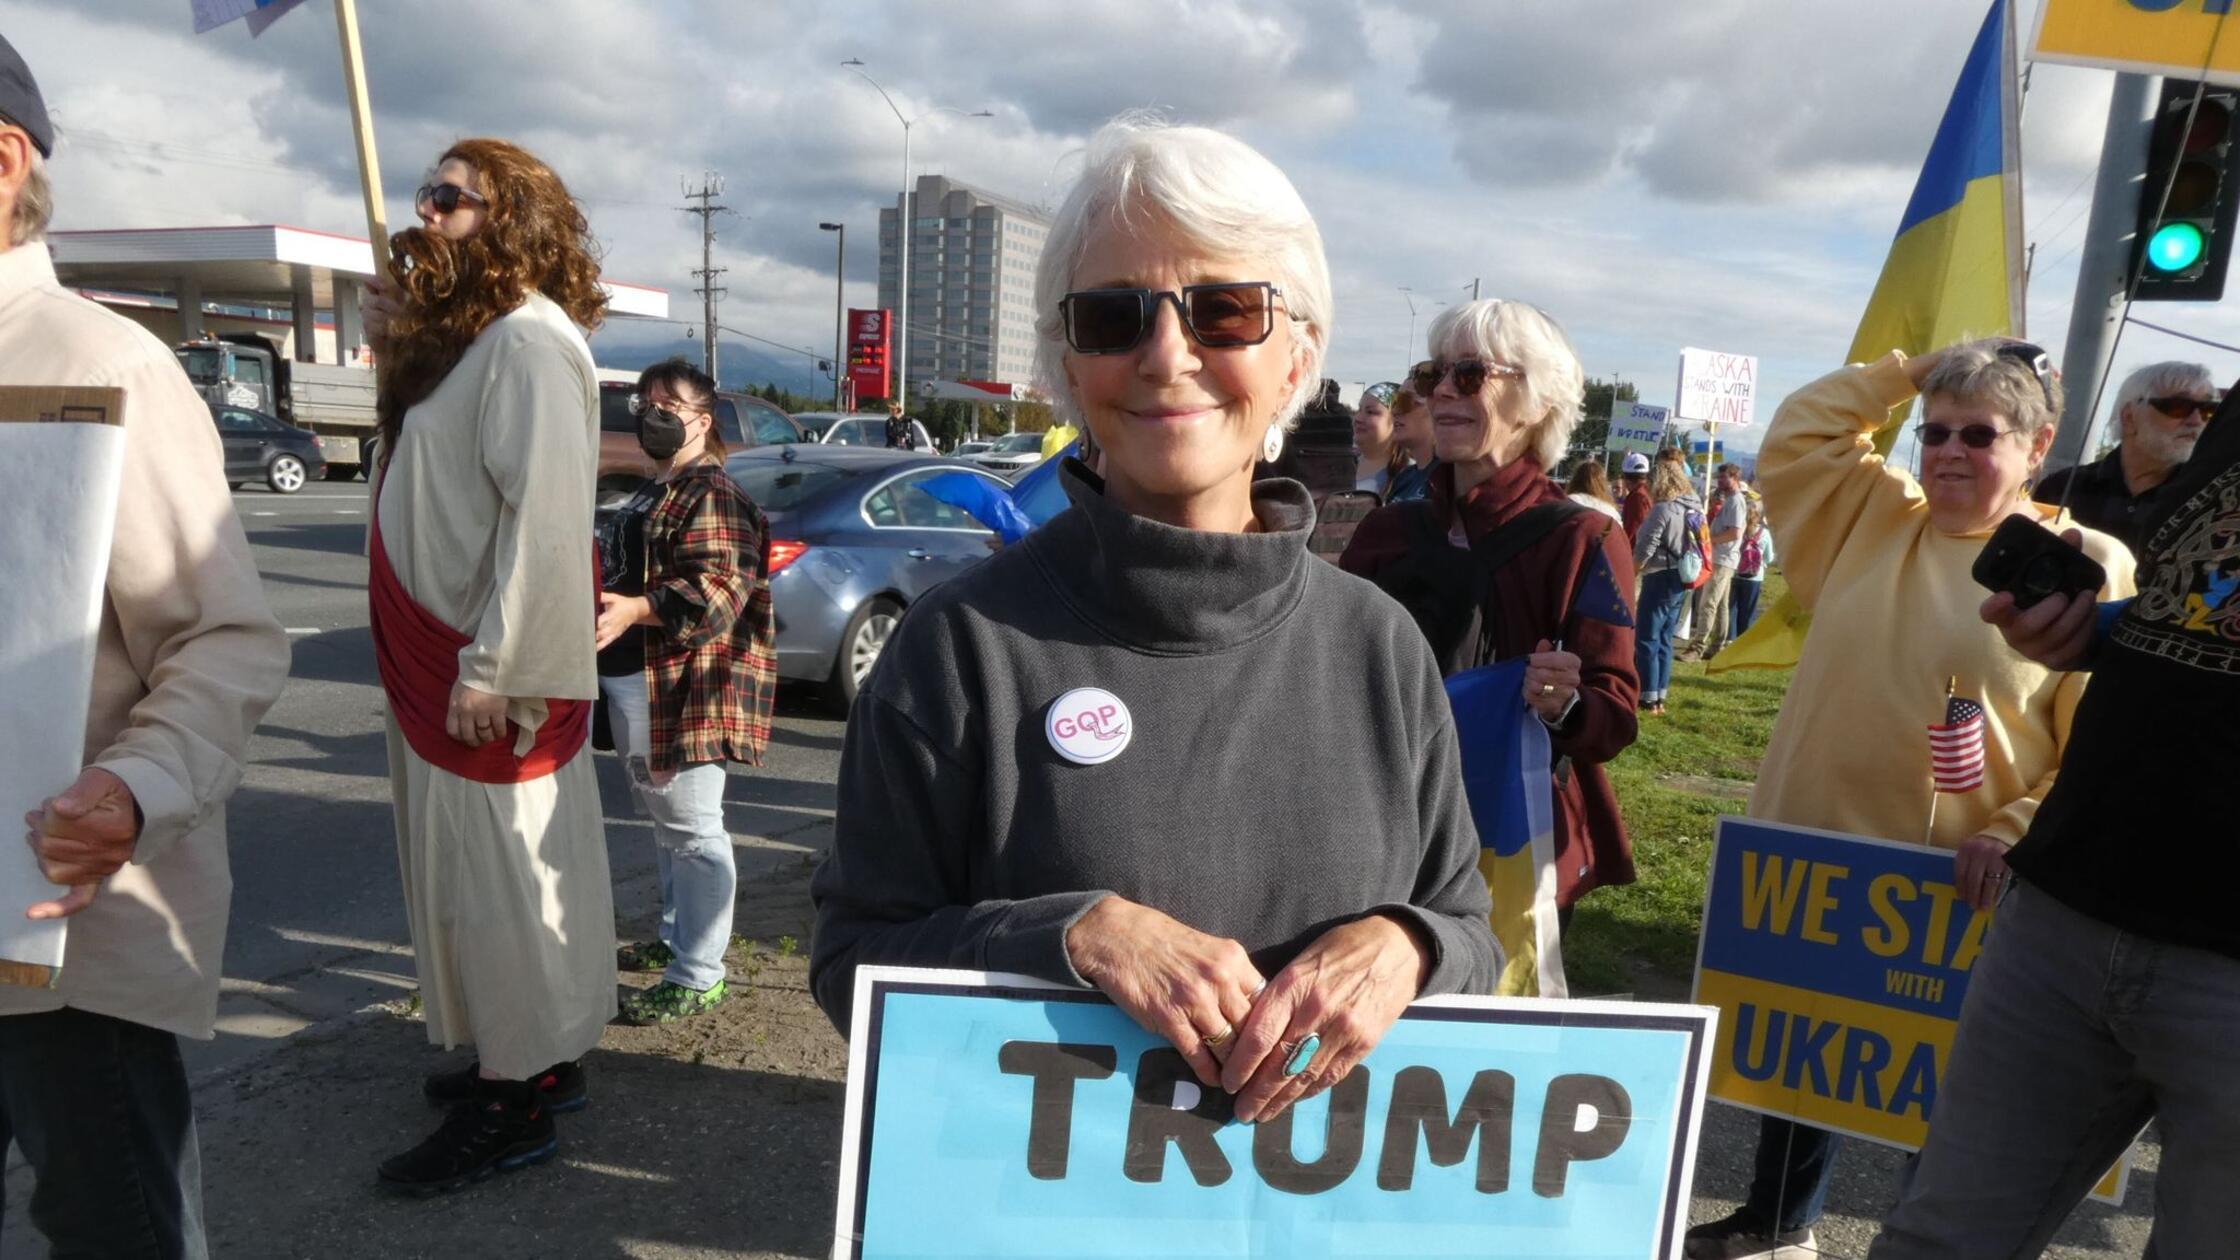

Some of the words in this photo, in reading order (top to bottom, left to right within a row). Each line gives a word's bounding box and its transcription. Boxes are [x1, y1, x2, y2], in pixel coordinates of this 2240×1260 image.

[1722, 382, 1751, 397] WITH
[1630, 405, 1666, 422] STAND
[1742, 851, 1849, 945] WE
[1885, 969, 1944, 1003] WITH
[998, 1040, 1632, 1197] TRUMP
